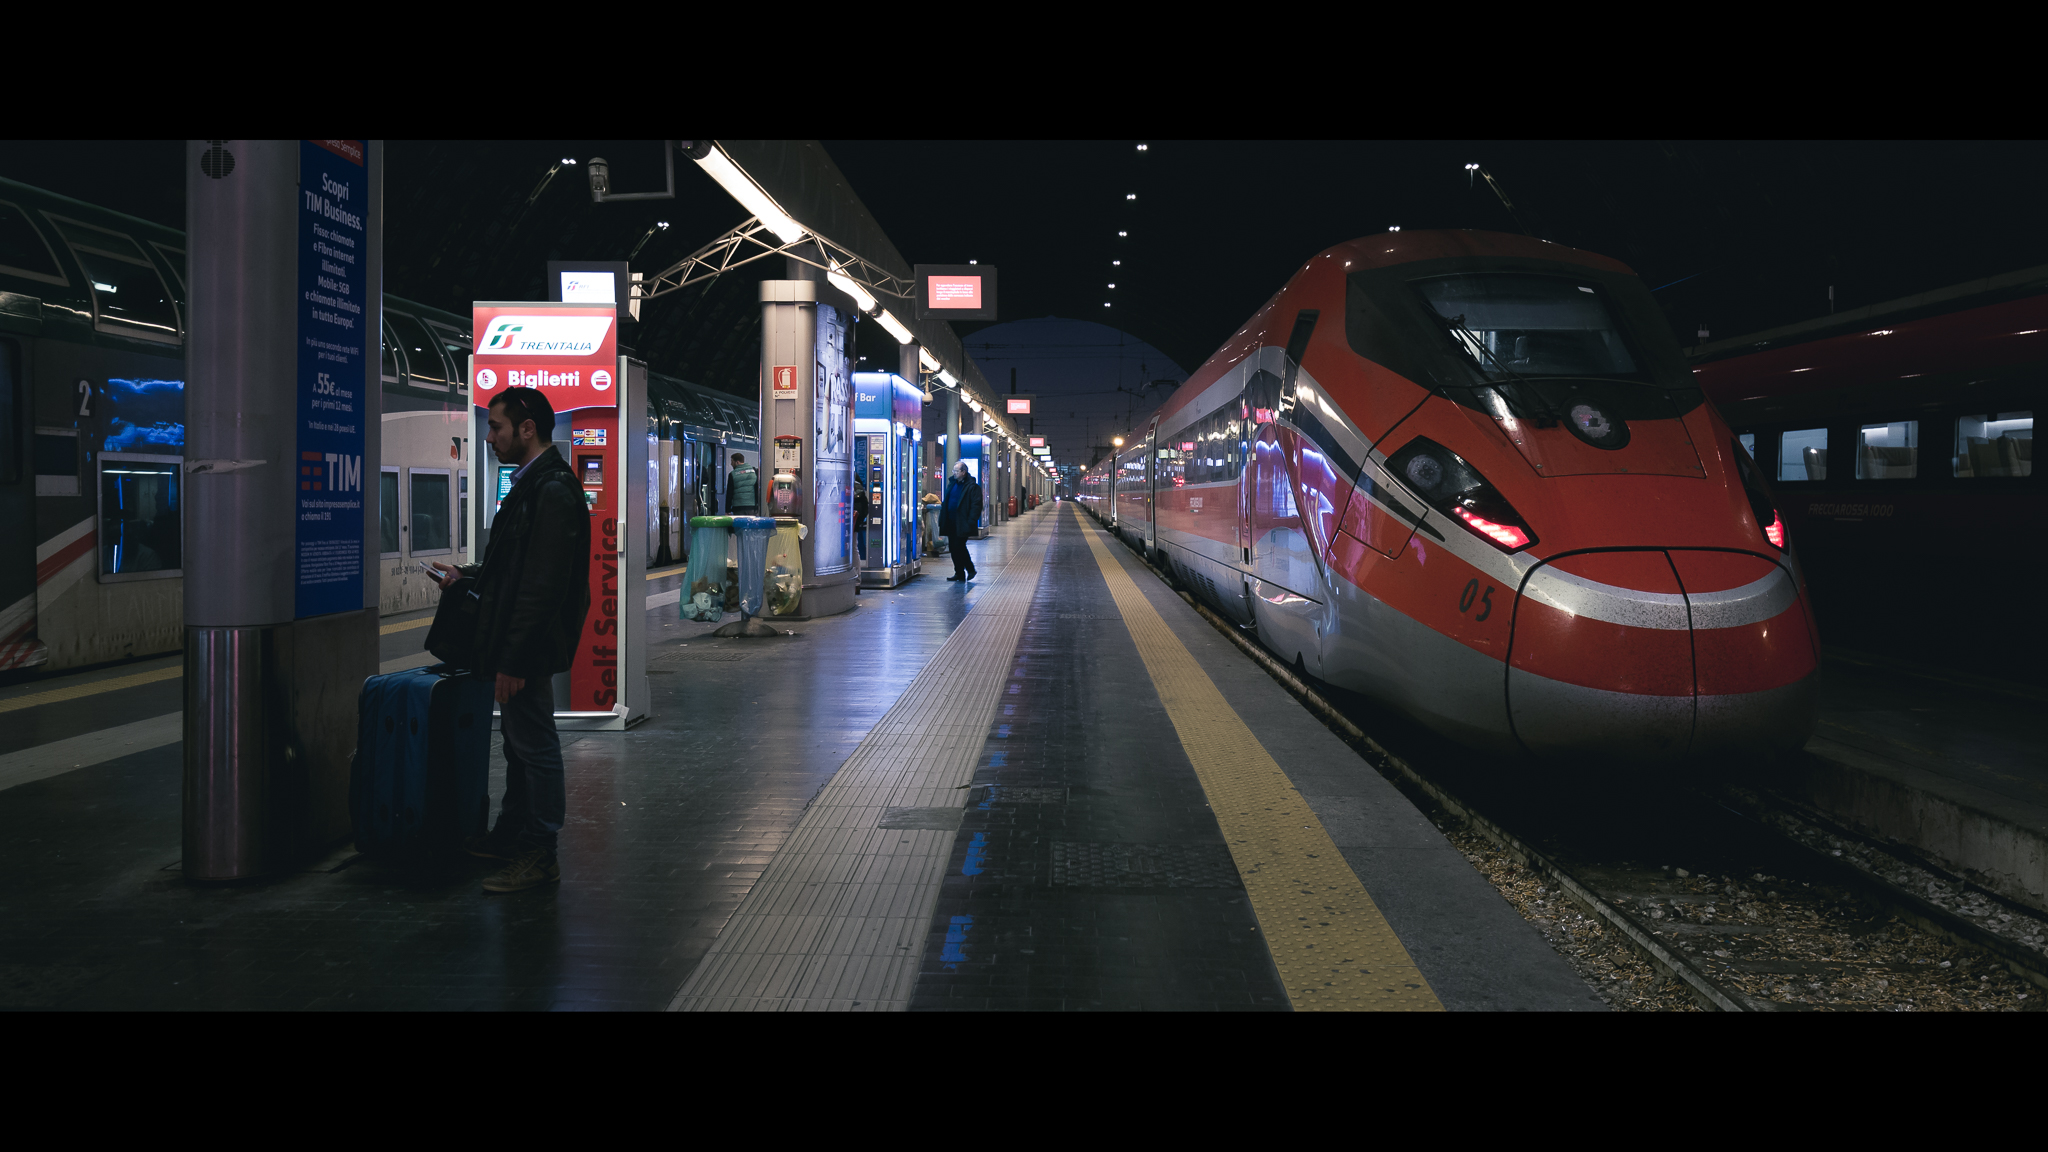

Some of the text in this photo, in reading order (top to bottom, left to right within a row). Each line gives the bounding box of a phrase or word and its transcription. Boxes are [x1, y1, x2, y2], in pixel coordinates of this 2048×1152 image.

[322, 172, 349, 202] Scopri
[305, 190, 362, 231] TIM Business.
[313, 222, 355, 248] Fisso: chiamate
[313, 241, 355, 265] e Fibra internet
[321, 259, 346, 278] illimitati.
[318, 275, 350, 295] Mobile: 5GB
[305, 289, 360, 315] e chiamate illimitate
[312, 306, 318, 319] in
[318, 309, 334, 323] tutta
[306, 336, 310, 345] In
[317, 340, 325, 349] una
[325, 342, 341, 352] seconda
[341, 345, 350, 354] rete
[350, 346, 359, 356] WiFi
[520, 341, 592, 351] TRENITALIA
[327, 352, 335, 361] tuoi
[336, 354, 348, 364] clienti.
[312, 372, 352, 399] A 55€ al mese
[508, 370, 580, 389] Biglietti
[79, 380, 90, 416] 2
[311, 399, 320, 409] per
[323, 399, 335, 411] primi
[336, 401, 341, 411] 12
[341, 402, 353, 412] mesi.
[860, 392, 876, 402] Bar
[325, 453, 361, 492] TIM
[301, 499, 309, 508] Vai
[1808, 503, 1894, 517] FRECCIAROSSA 1000
[305, 512, 320, 521] chiama
[1459, 578, 1495, 622] 05
[593, 517, 617, 706] Self Service
